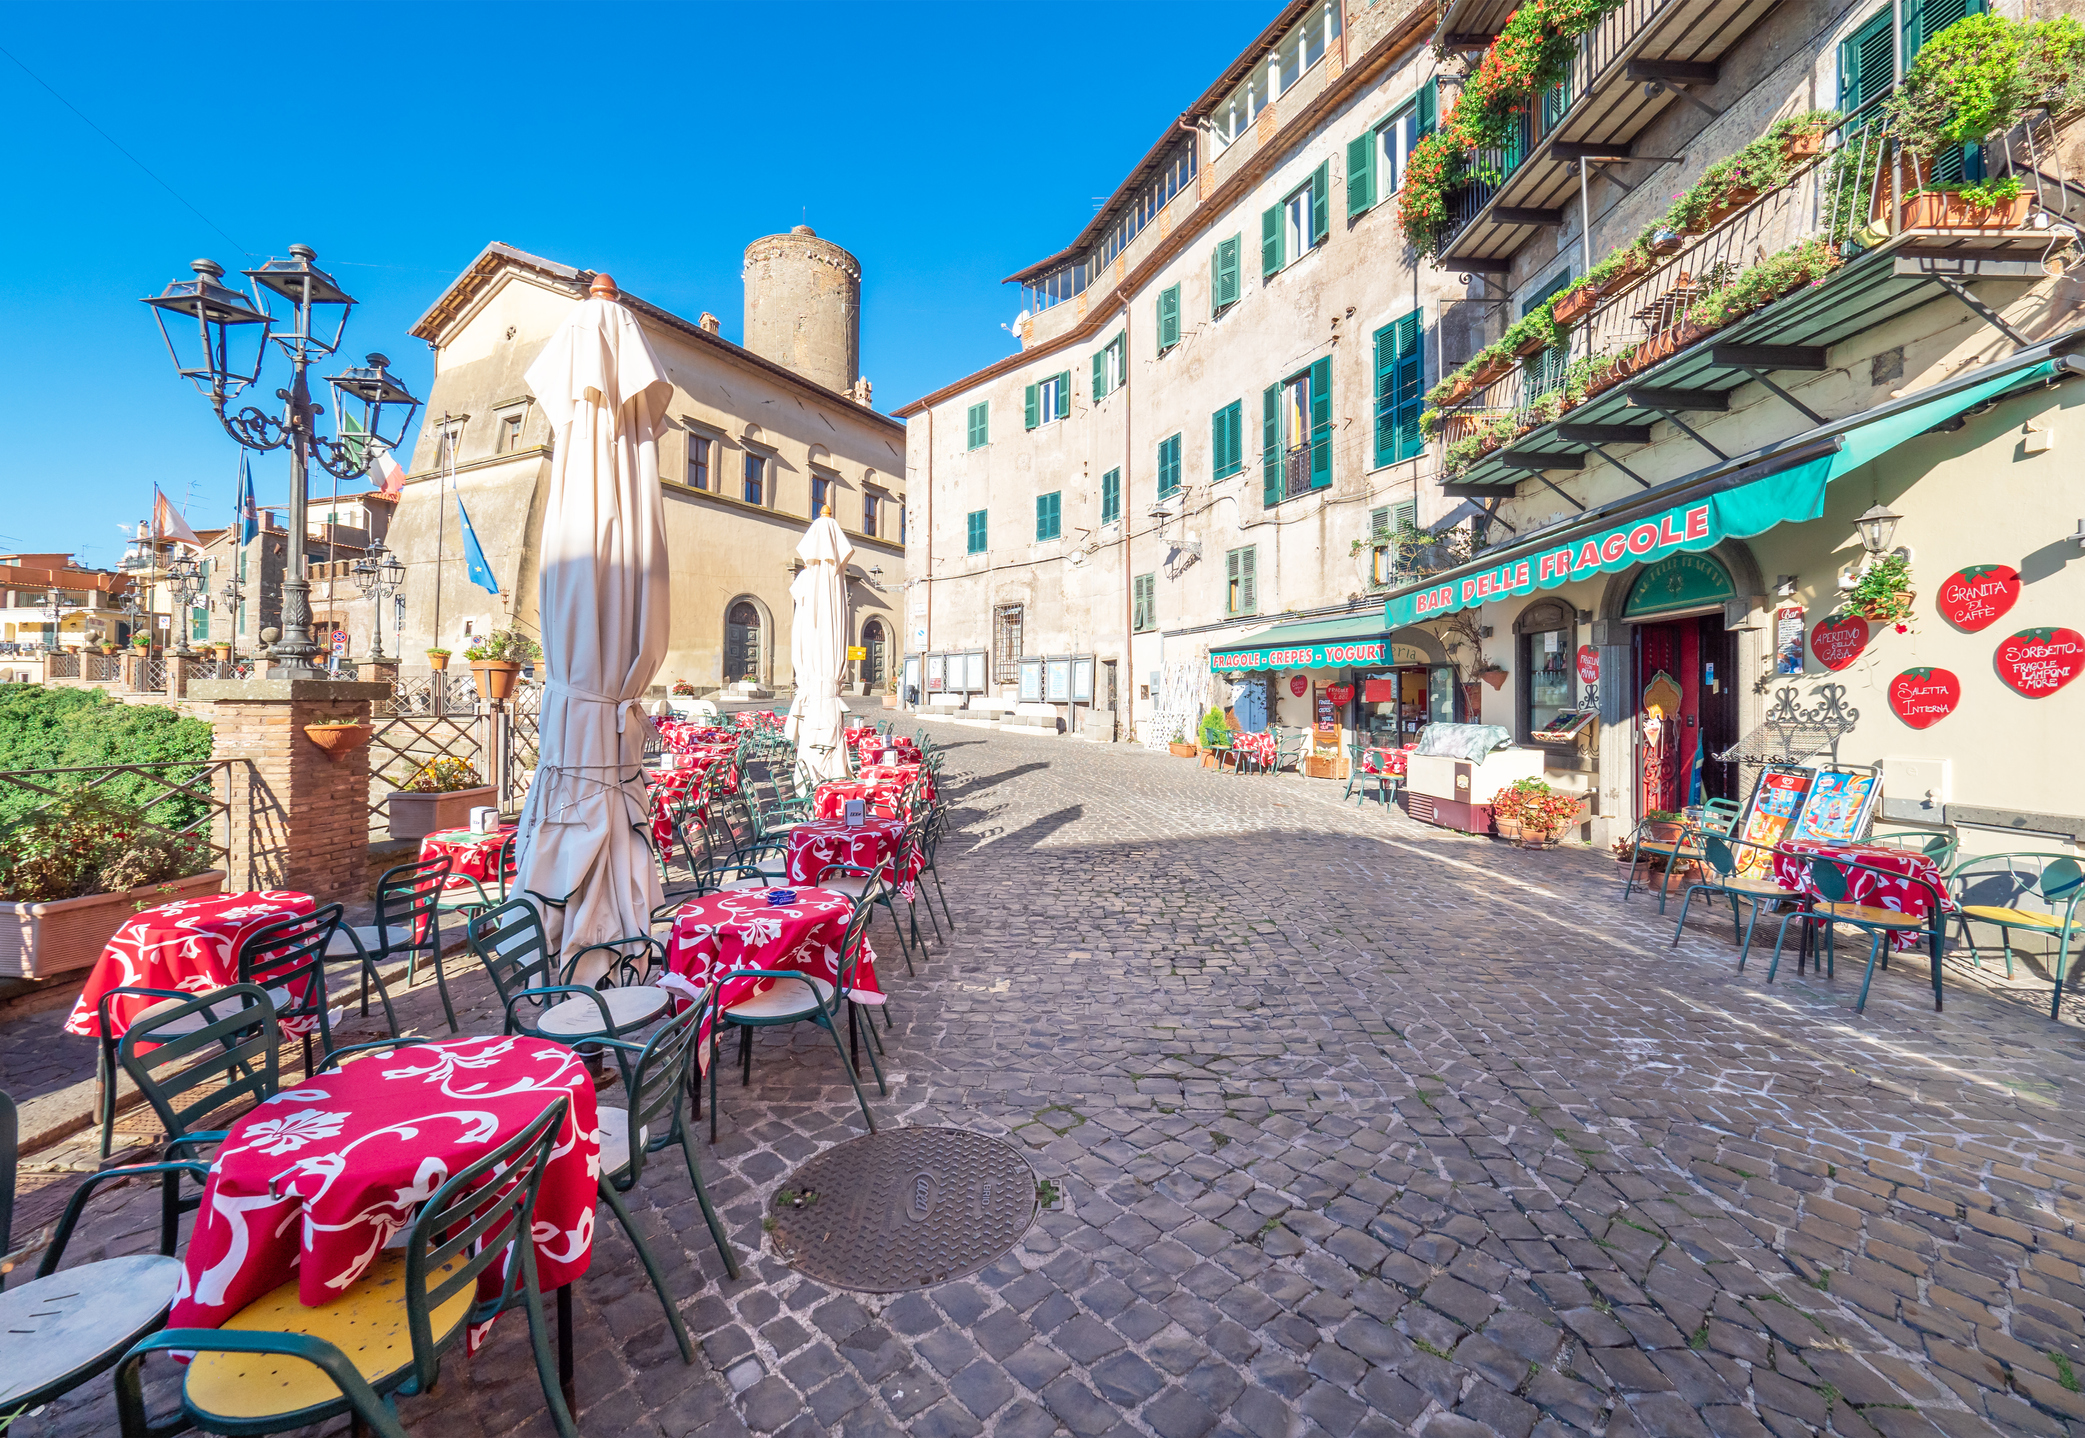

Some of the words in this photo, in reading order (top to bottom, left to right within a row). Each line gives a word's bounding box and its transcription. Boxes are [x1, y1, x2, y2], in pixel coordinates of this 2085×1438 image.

[1416, 587, 1452, 614] BAR
[1462, 562, 1530, 601] DELLE
[1539, 504, 1710, 581] FRAGOLE
[1947, 581, 2007, 603] GRANITA
[1954, 605, 1995, 622] CAFFÈ
[1814, 627, 1860, 645] APERITIVO
[1213, 652, 1260, 668] FRAGOLE
[1269, 648, 1313, 665] CREPES
[1325, 644, 1386, 663] YOGURT
[1822, 648, 1852, 661] CASA
[2005, 642, 2076, 662] SORBETTO
[2012, 660, 2058, 673] FRAGOLE
[2022, 666, 2071, 680] LAMPONI
[1897, 683, 1949, 700] SALETTA
[2025, 678, 2058, 689] MORE
[1903, 699, 1950, 715] INTERNA
[915, 1179, 929, 1212] acea
